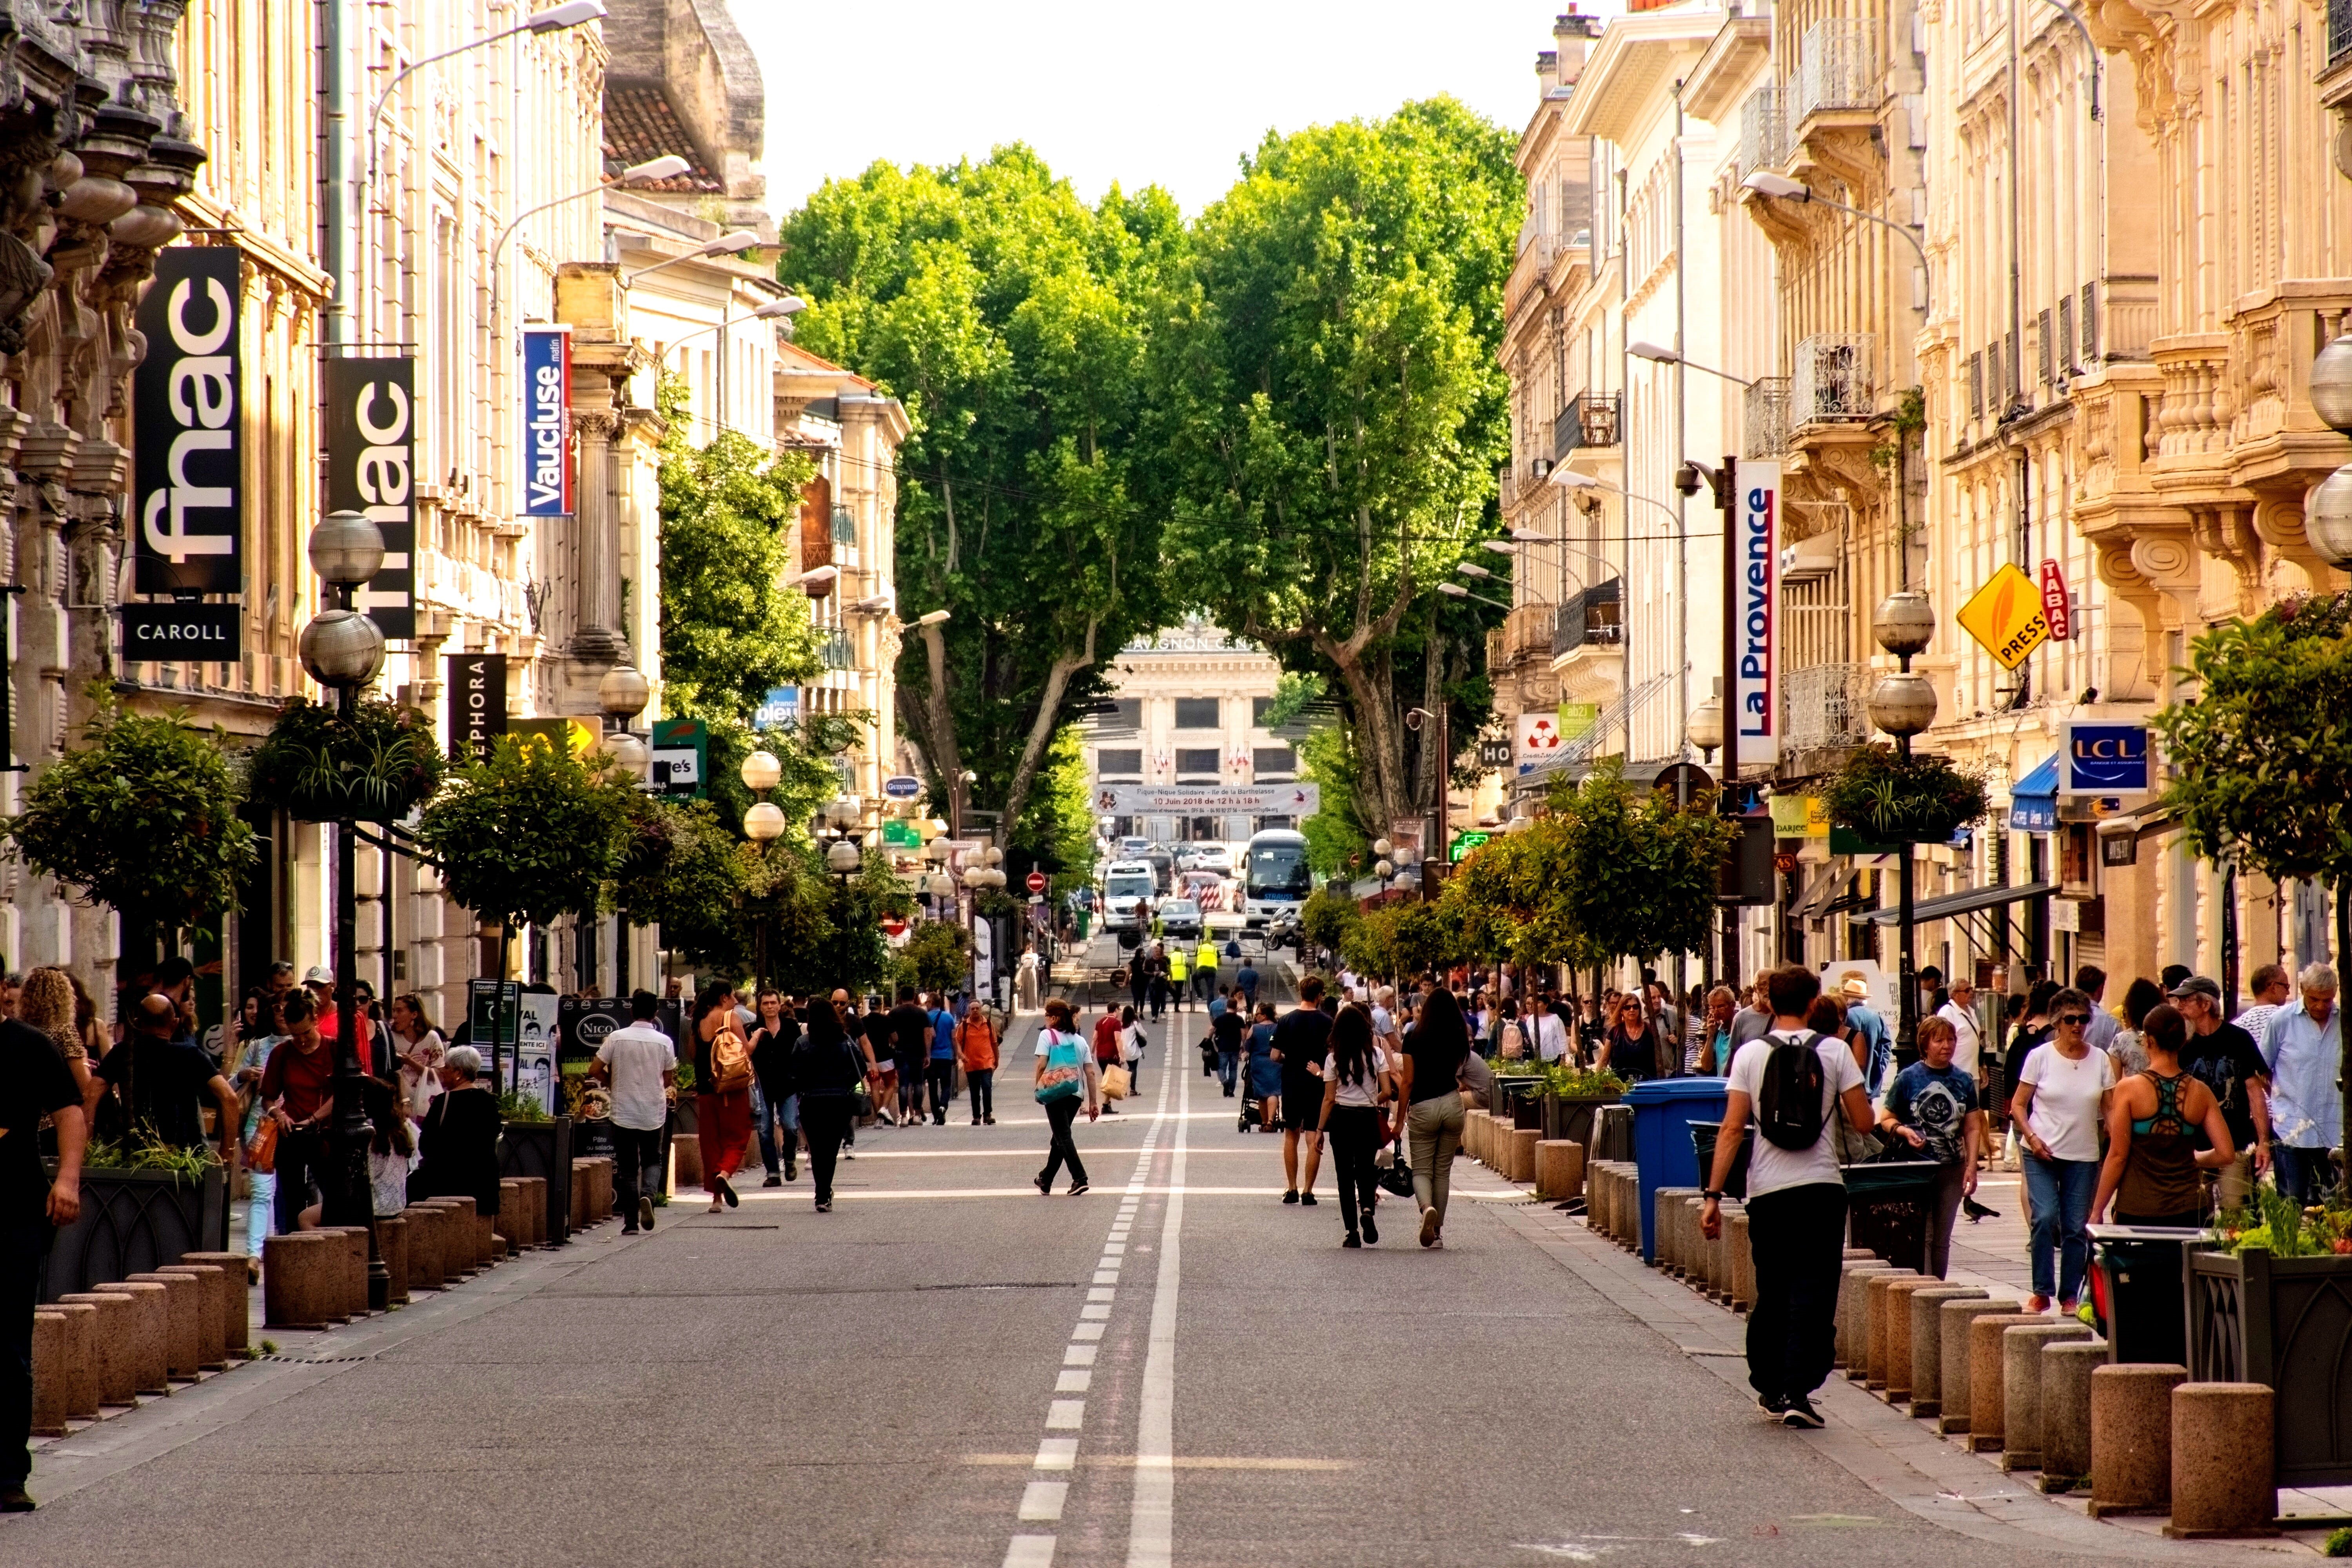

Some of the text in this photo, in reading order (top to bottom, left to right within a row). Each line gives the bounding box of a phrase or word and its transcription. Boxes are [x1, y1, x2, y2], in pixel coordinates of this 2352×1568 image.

[550, 338, 560, 362] matin
[144, 277, 232, 563] fnac
[530, 365, 560, 507] Vaucluse
[2043, 563, 2066, 637] TABAC
[1740, 488, 1768, 736] La Provence
[137, 625, 225, 640] CAROLL
[1134, 637, 1208, 650] AVGNON
[1567, 705, 1587, 717] ab2j
[2076, 739, 2137, 758] LCL
[671, 759, 691, 773] e's
[1776, 857, 1790, 868] AS
